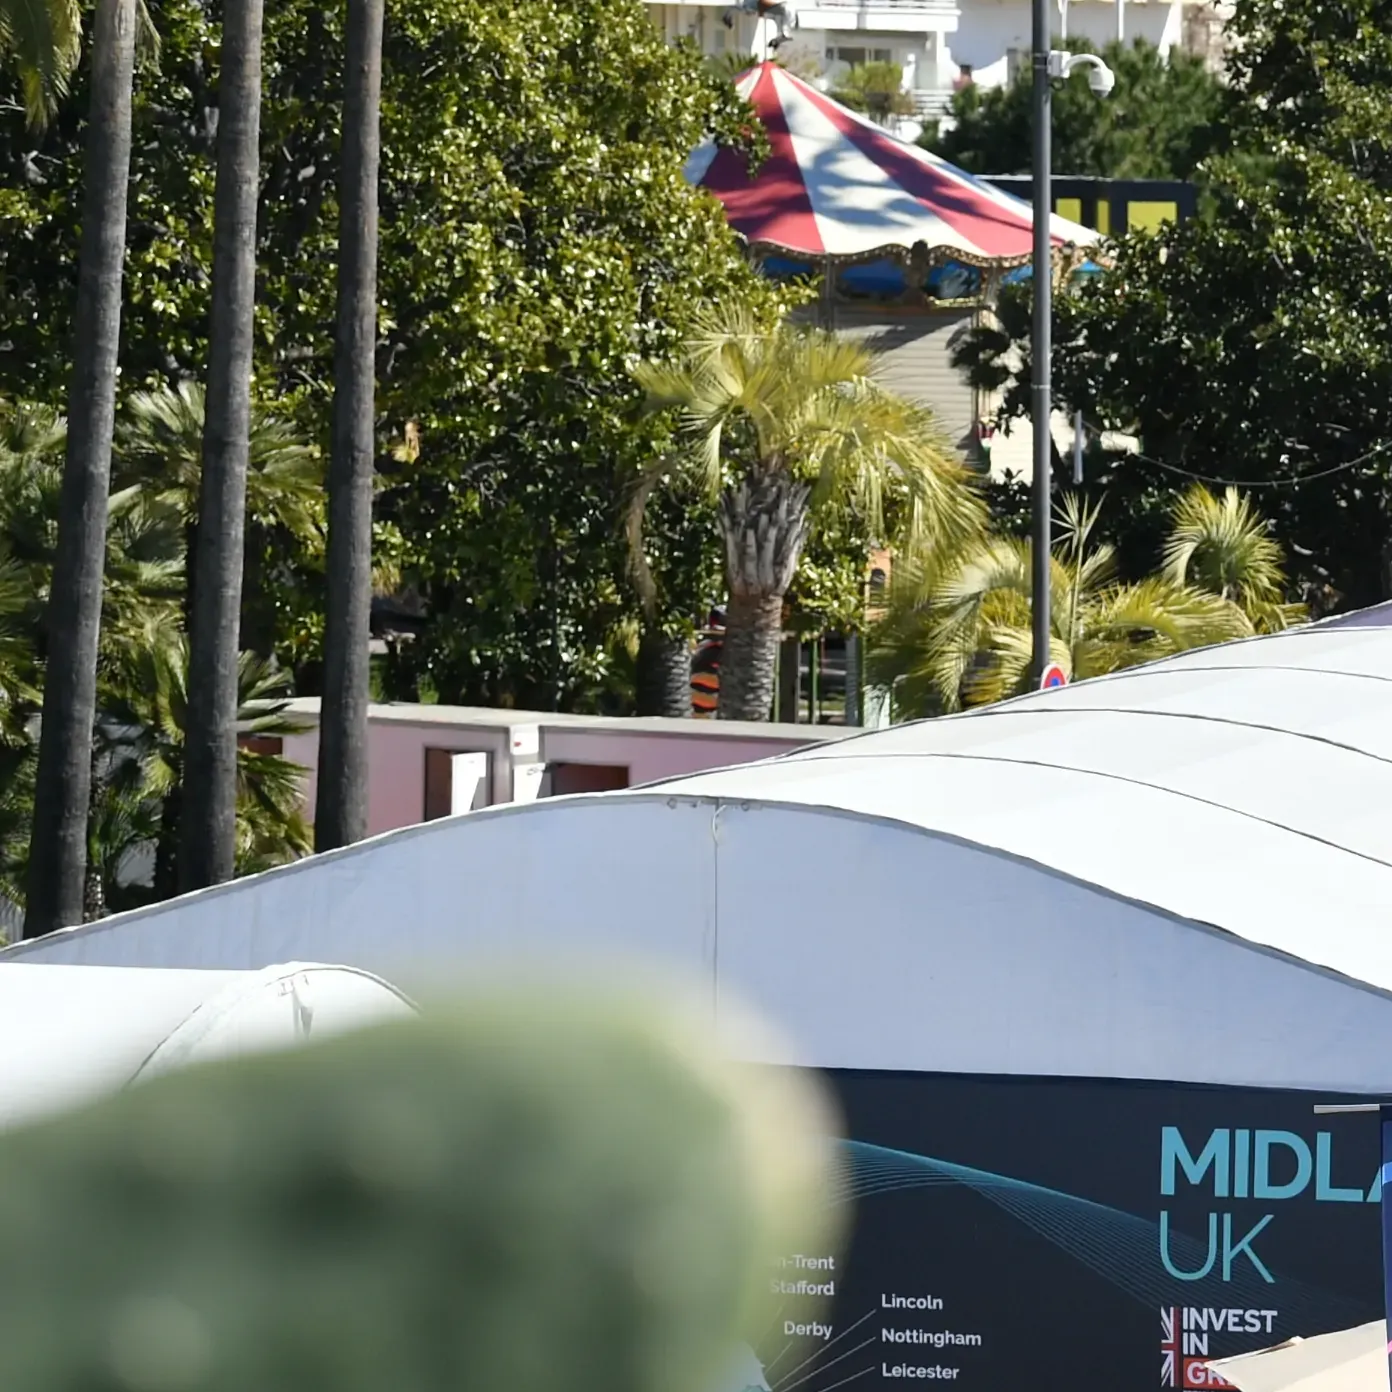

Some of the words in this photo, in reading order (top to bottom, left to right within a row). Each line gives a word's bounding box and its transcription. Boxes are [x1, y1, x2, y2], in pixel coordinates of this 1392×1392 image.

[1160, 1211, 1275, 1283] UK
[771, 1280, 835, 1296] Stafford
[881, 1294, 943, 1310] Lincoln
[1183, 1307, 1278, 1333] INVEST
[784, 1321, 833, 1340] Derby
[881, 1328, 982, 1348] Nottingham
[1183, 1332, 1208, 1356] IN
[882, 1363, 959, 1379] Leicester
